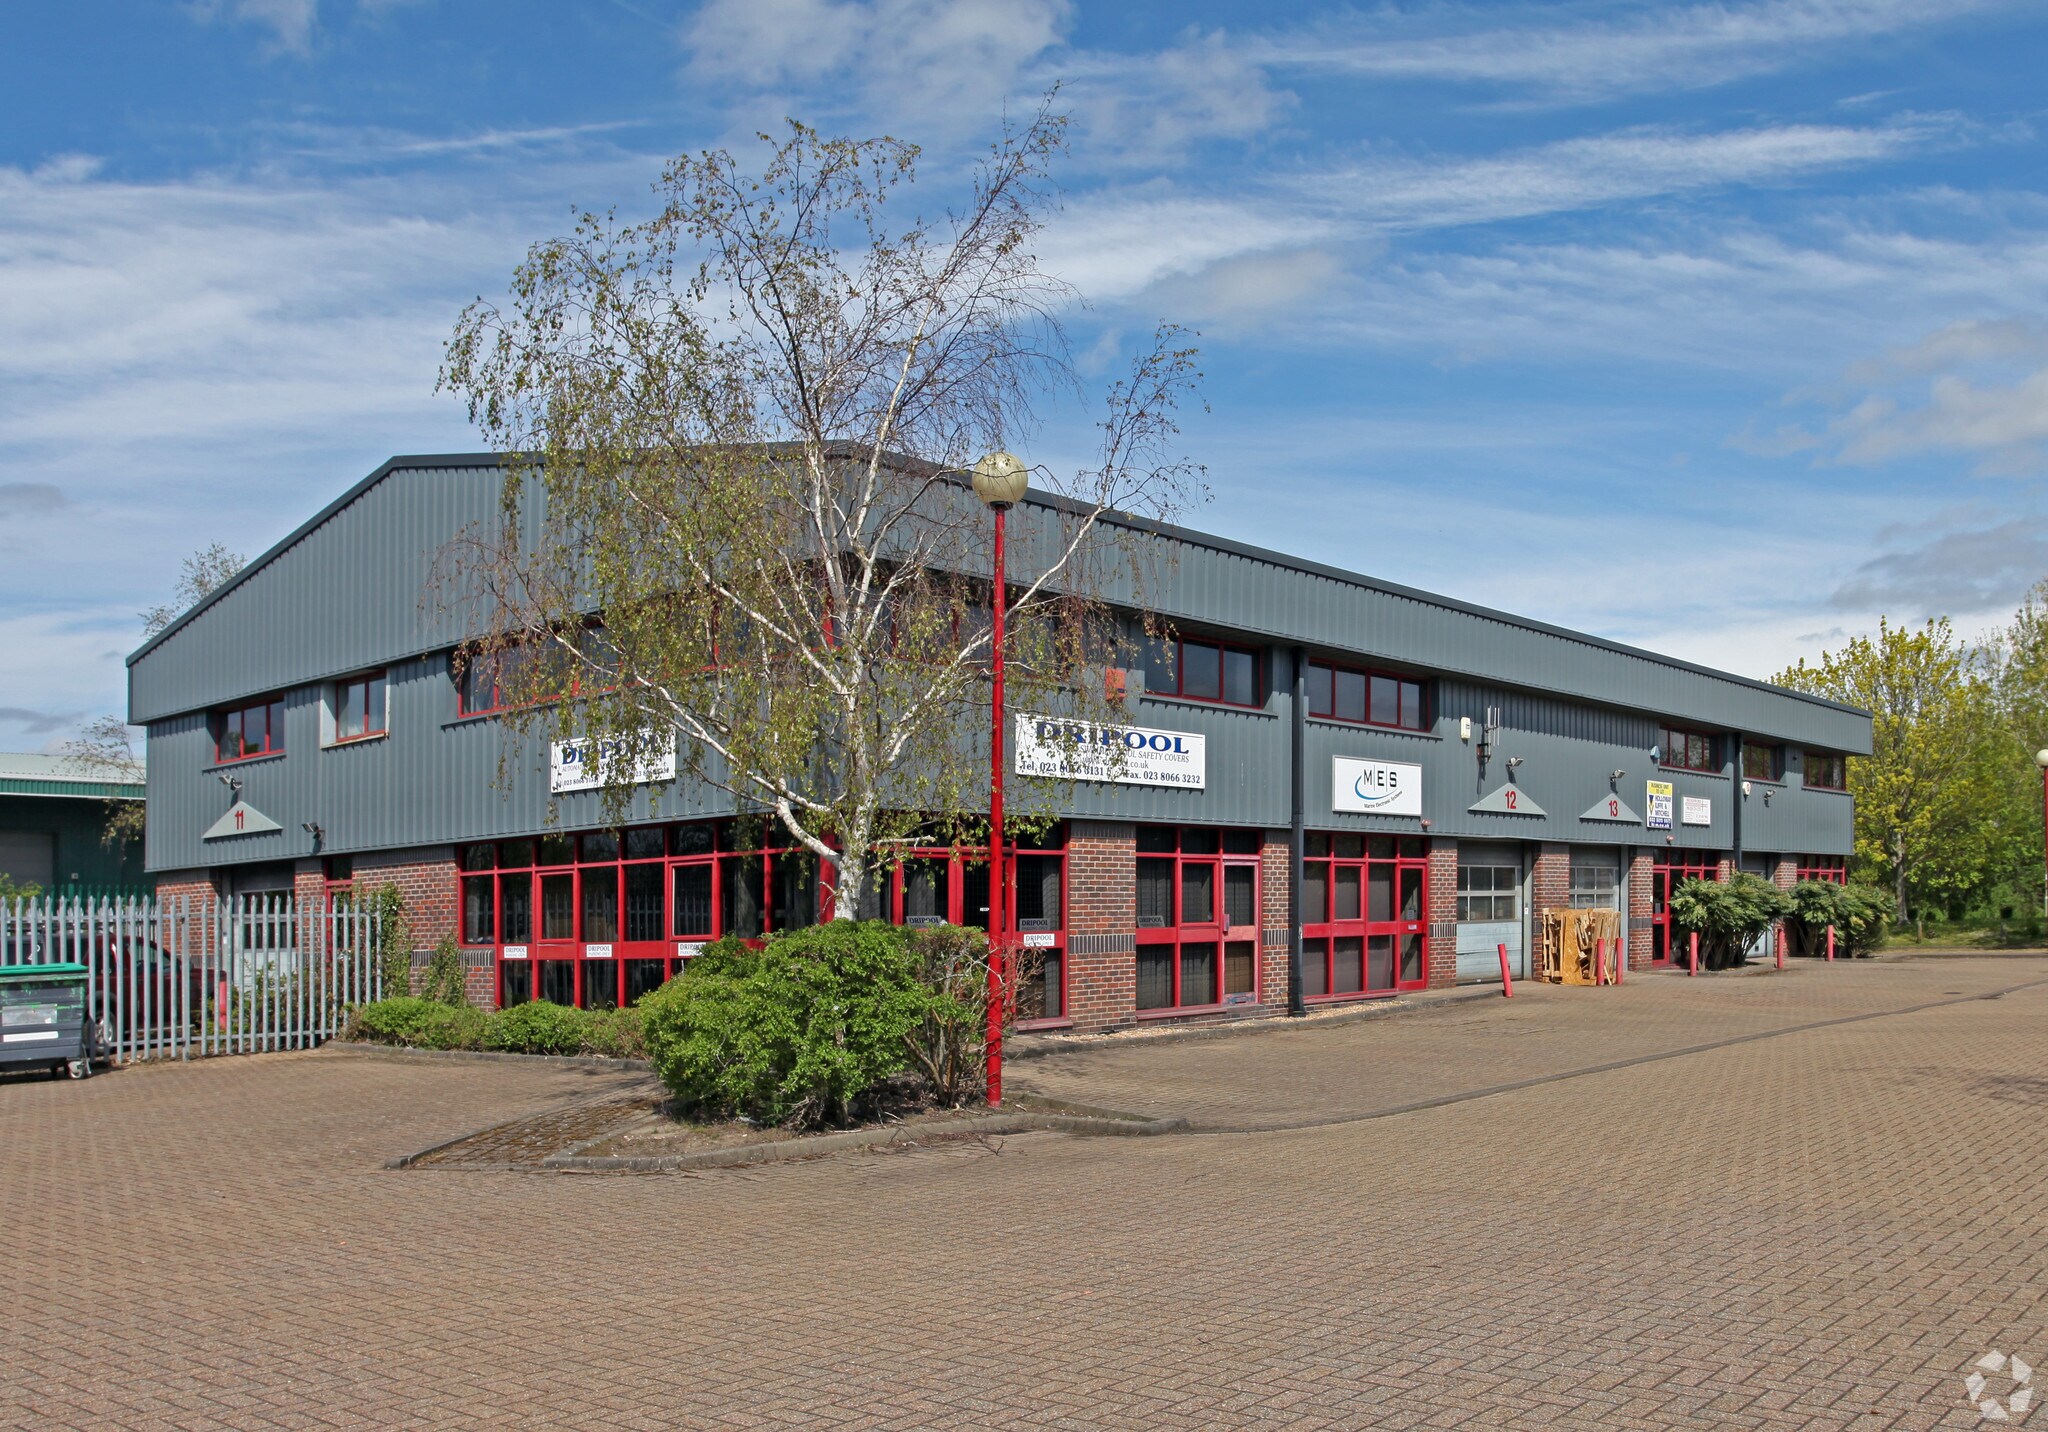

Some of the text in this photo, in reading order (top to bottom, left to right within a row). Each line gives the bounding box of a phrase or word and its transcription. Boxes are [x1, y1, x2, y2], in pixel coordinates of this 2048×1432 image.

[1138, 750, 1164, 761] SAFETY
[1164, 753, 1190, 763] COVERS
[1143, 770, 1158, 780] 023
[1160, 772, 1180, 782] 8066
[1182, 774, 1201, 784] 3232
[1363, 768, 1397, 788] MES
[1505, 791, 1517, 810] 12
[1609, 800, 1618, 817] 13
[234, 810, 244, 830] 11
[1025, 934, 1053, 942] DRIPOOL
